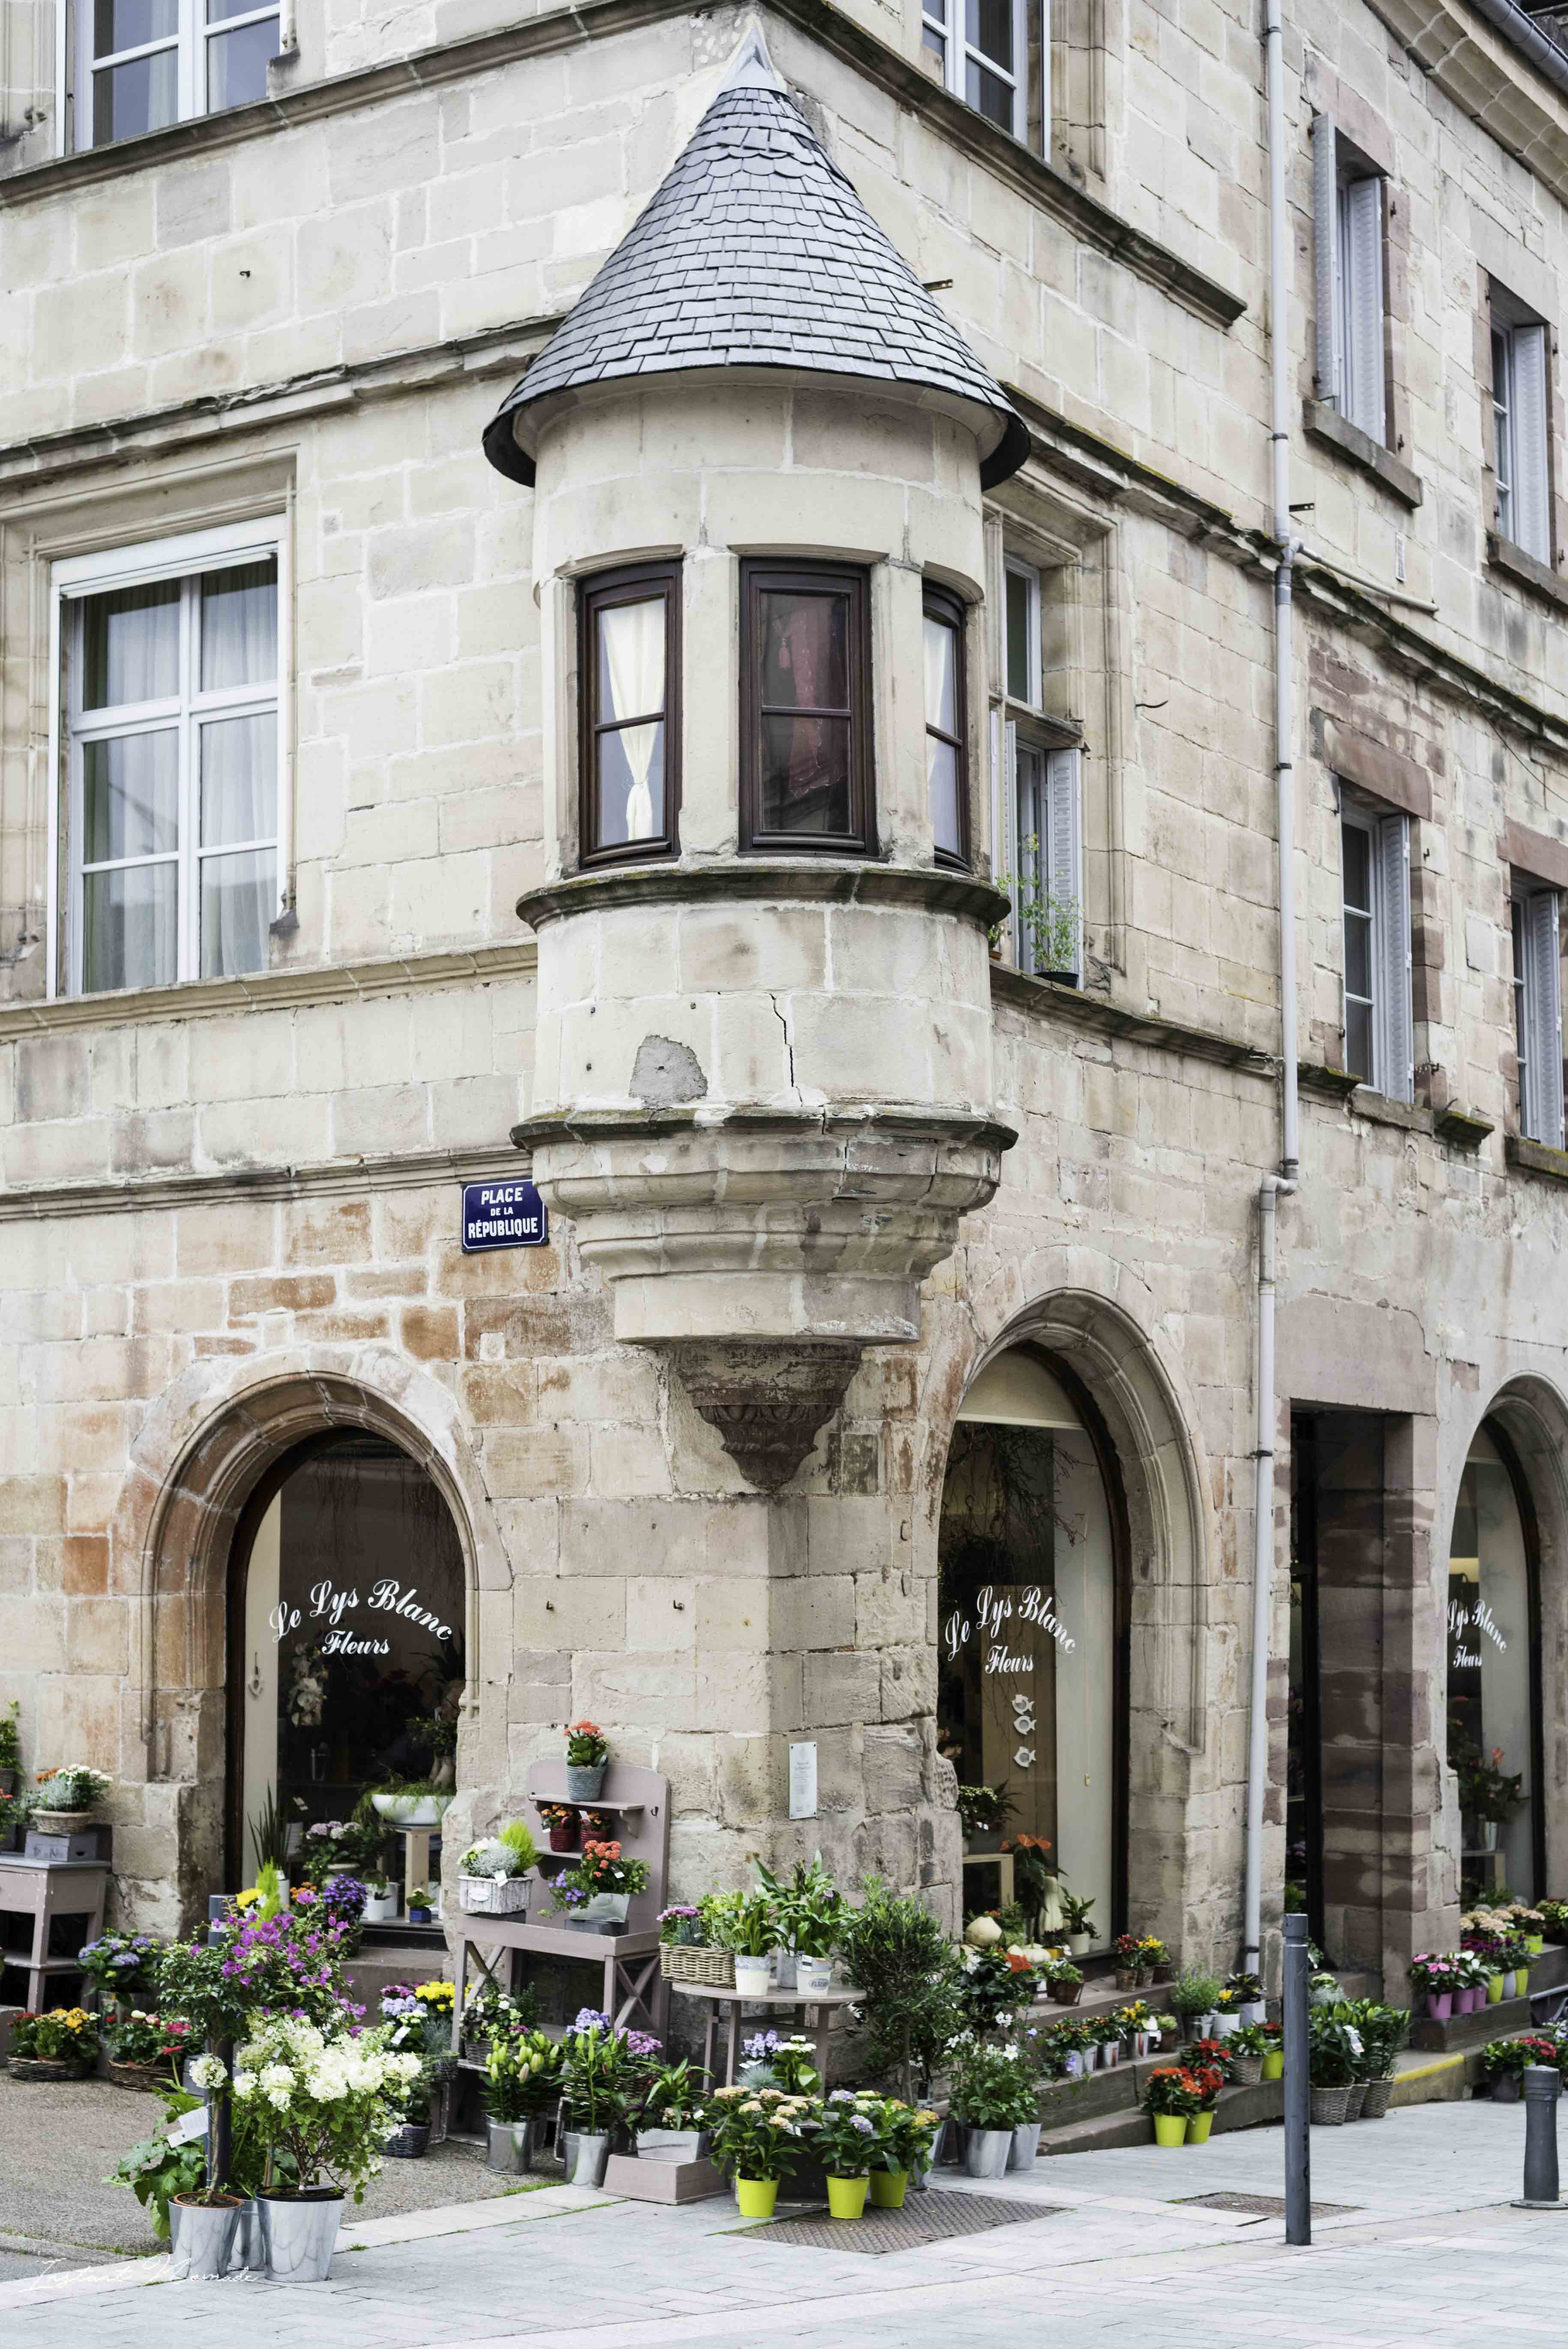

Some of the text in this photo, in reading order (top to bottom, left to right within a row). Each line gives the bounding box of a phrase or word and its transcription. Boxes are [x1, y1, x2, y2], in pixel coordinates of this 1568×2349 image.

[481, 1187, 523, 1205] PLACE
[491, 1208, 500, 1216] DE
[468, 1218, 538, 1238] RÉPUBLIQUE
[269, 1579, 452, 1643] Le Lys Blanc
[945, 1586, 1076, 1661] Le Lys Blanc
[1447, 1599, 1507, 1654] Lys Blanc
[322, 1631, 391, 1655] Fleurs
[985, 1646, 1034, 1674] Fleurs
[1453, 1645, 1482, 1668] Fleurs
